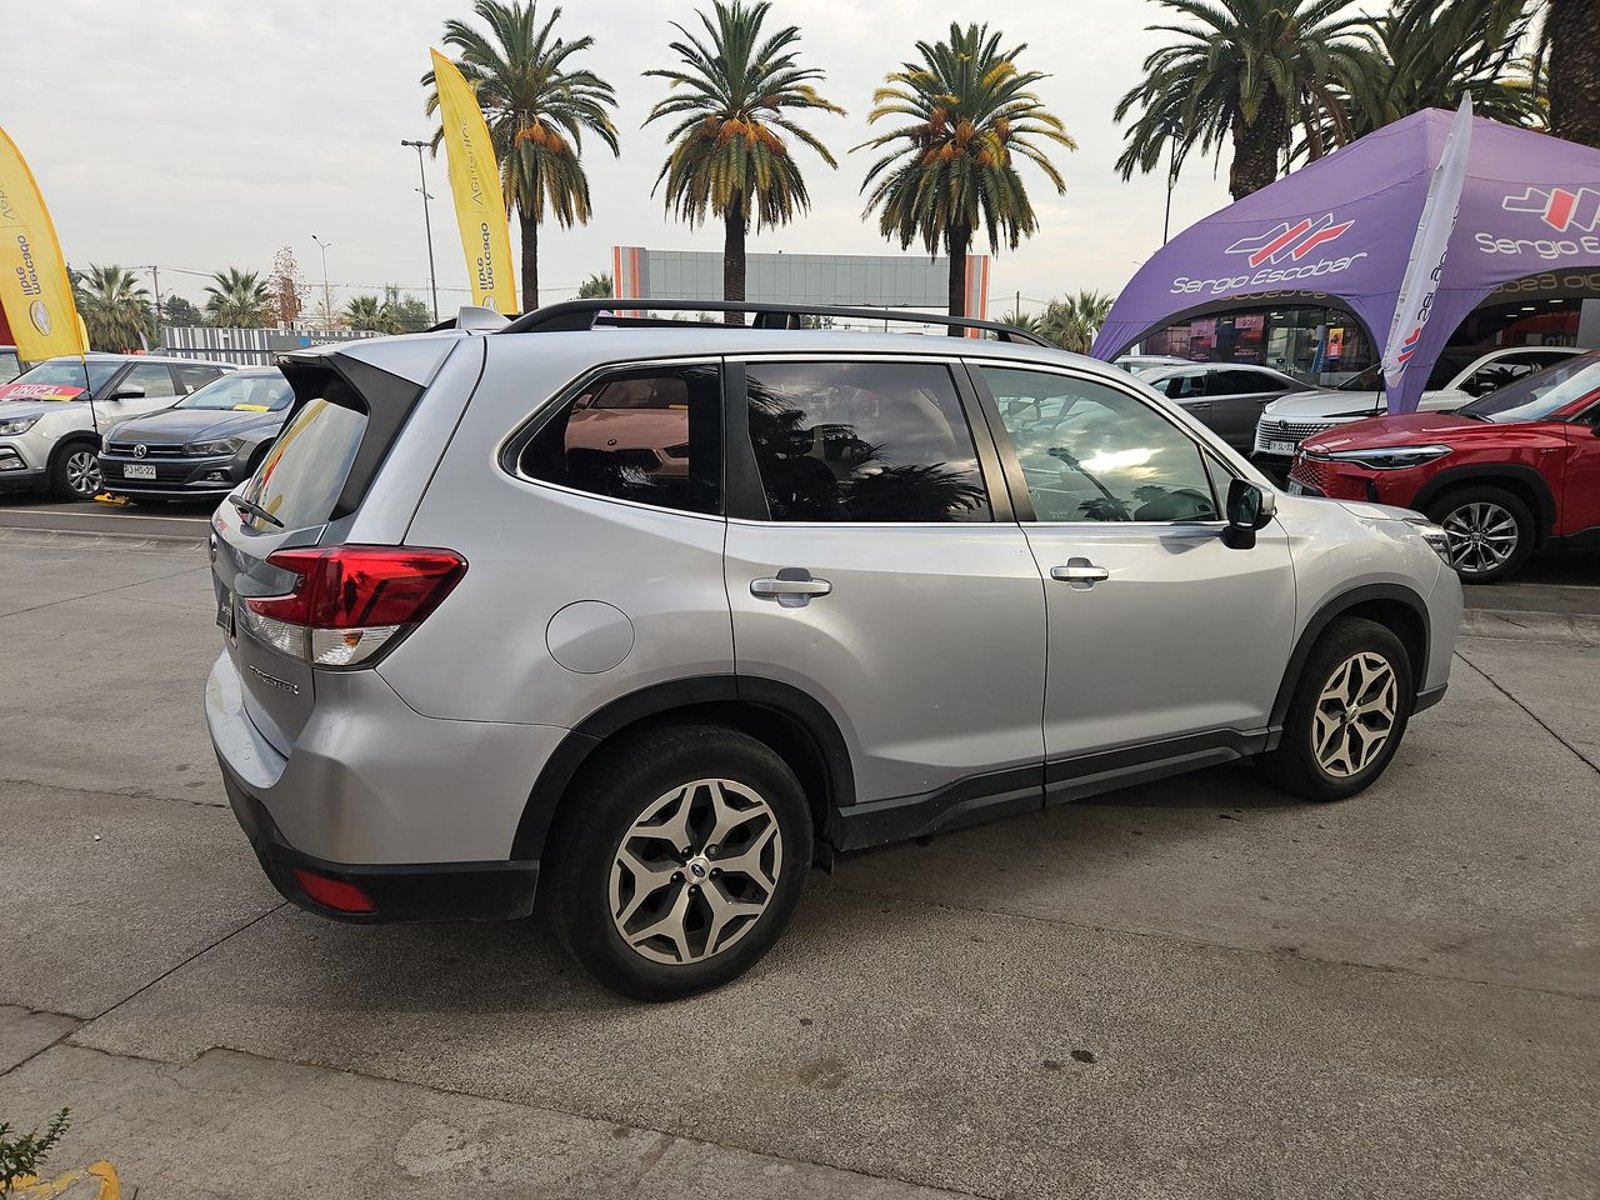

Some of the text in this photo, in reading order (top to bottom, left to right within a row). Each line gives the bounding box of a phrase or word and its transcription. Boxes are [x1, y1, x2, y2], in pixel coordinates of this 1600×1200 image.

[1475, 233, 1579, 259] Sergio
[1170, 275, 1249, 294] Sergio
[1250, 252, 1368, 285] Escobar
